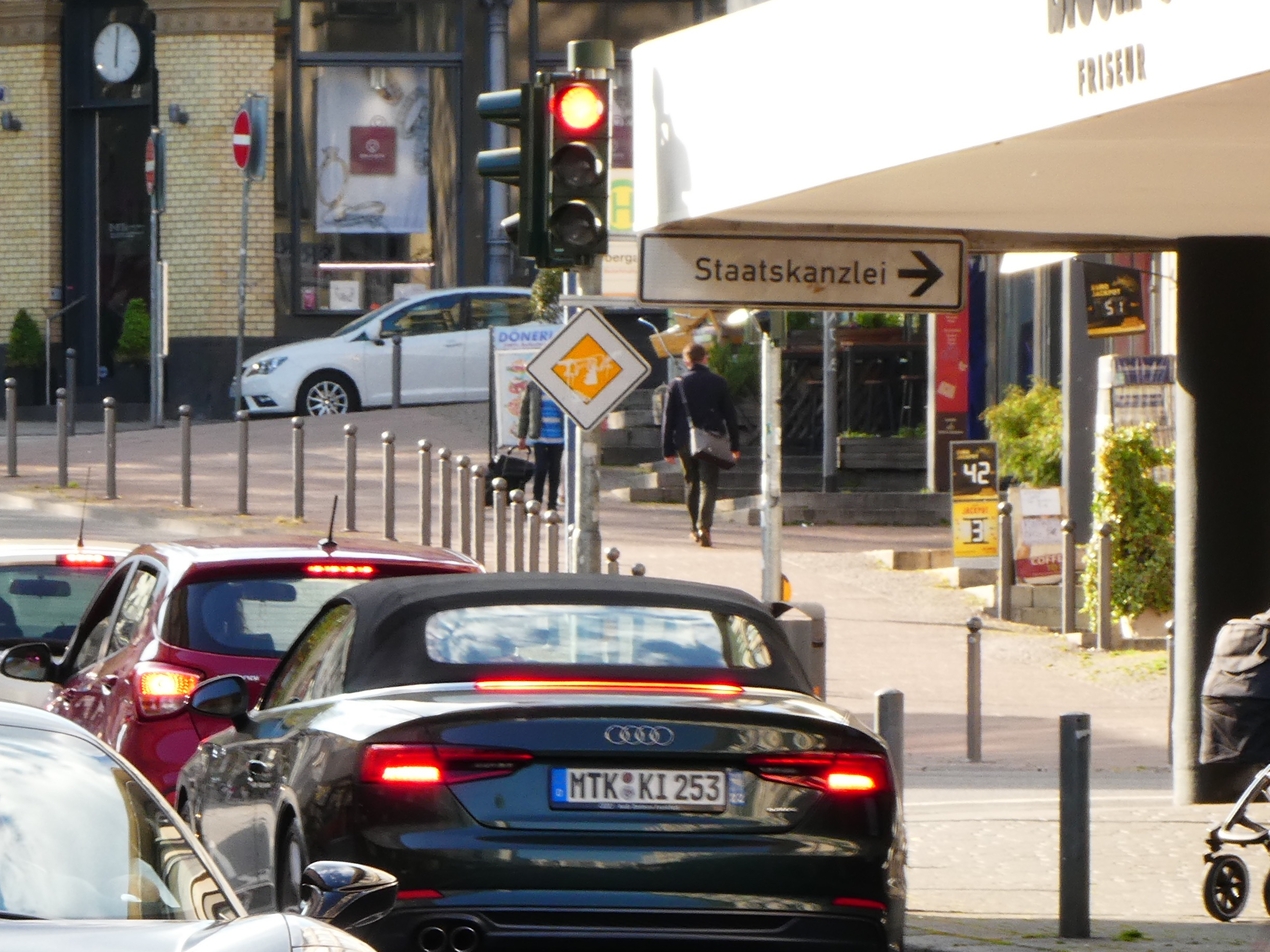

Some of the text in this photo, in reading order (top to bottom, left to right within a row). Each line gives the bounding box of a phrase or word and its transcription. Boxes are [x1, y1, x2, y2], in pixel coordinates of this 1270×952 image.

[1078, 43, 1146, 96] FRISEUR
[695, 256, 886, 285] Staatskanzlei
[963, 460, 991, 485] 42
[570, 772, 619, 799] MTK
[639, 773, 667, 800] KI
[674, 775, 720, 801] 253
